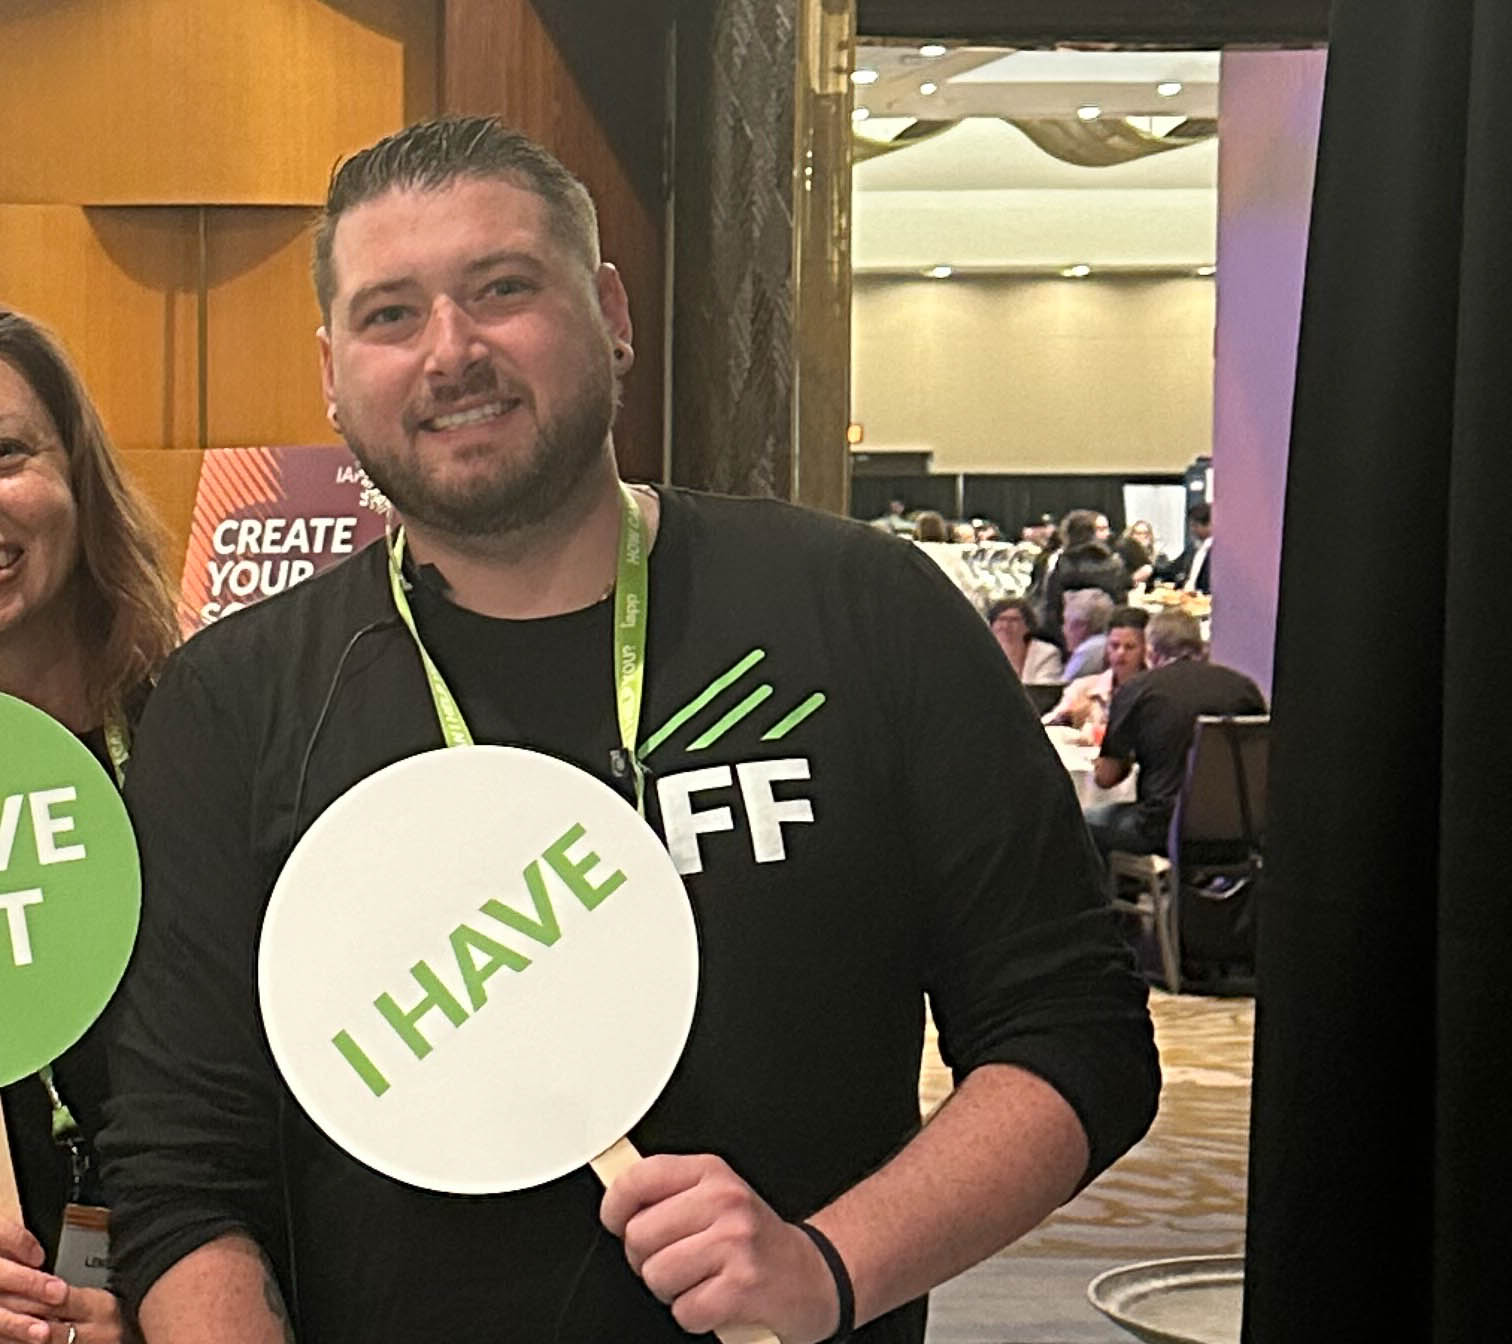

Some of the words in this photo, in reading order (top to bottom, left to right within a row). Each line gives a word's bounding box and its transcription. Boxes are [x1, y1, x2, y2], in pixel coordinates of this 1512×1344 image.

[213, 517, 357, 555] CREATE
[207, 560, 315, 597] YOUR
[331, 1029, 391, 1097] I
[373, 822, 628, 1061] HAVE
